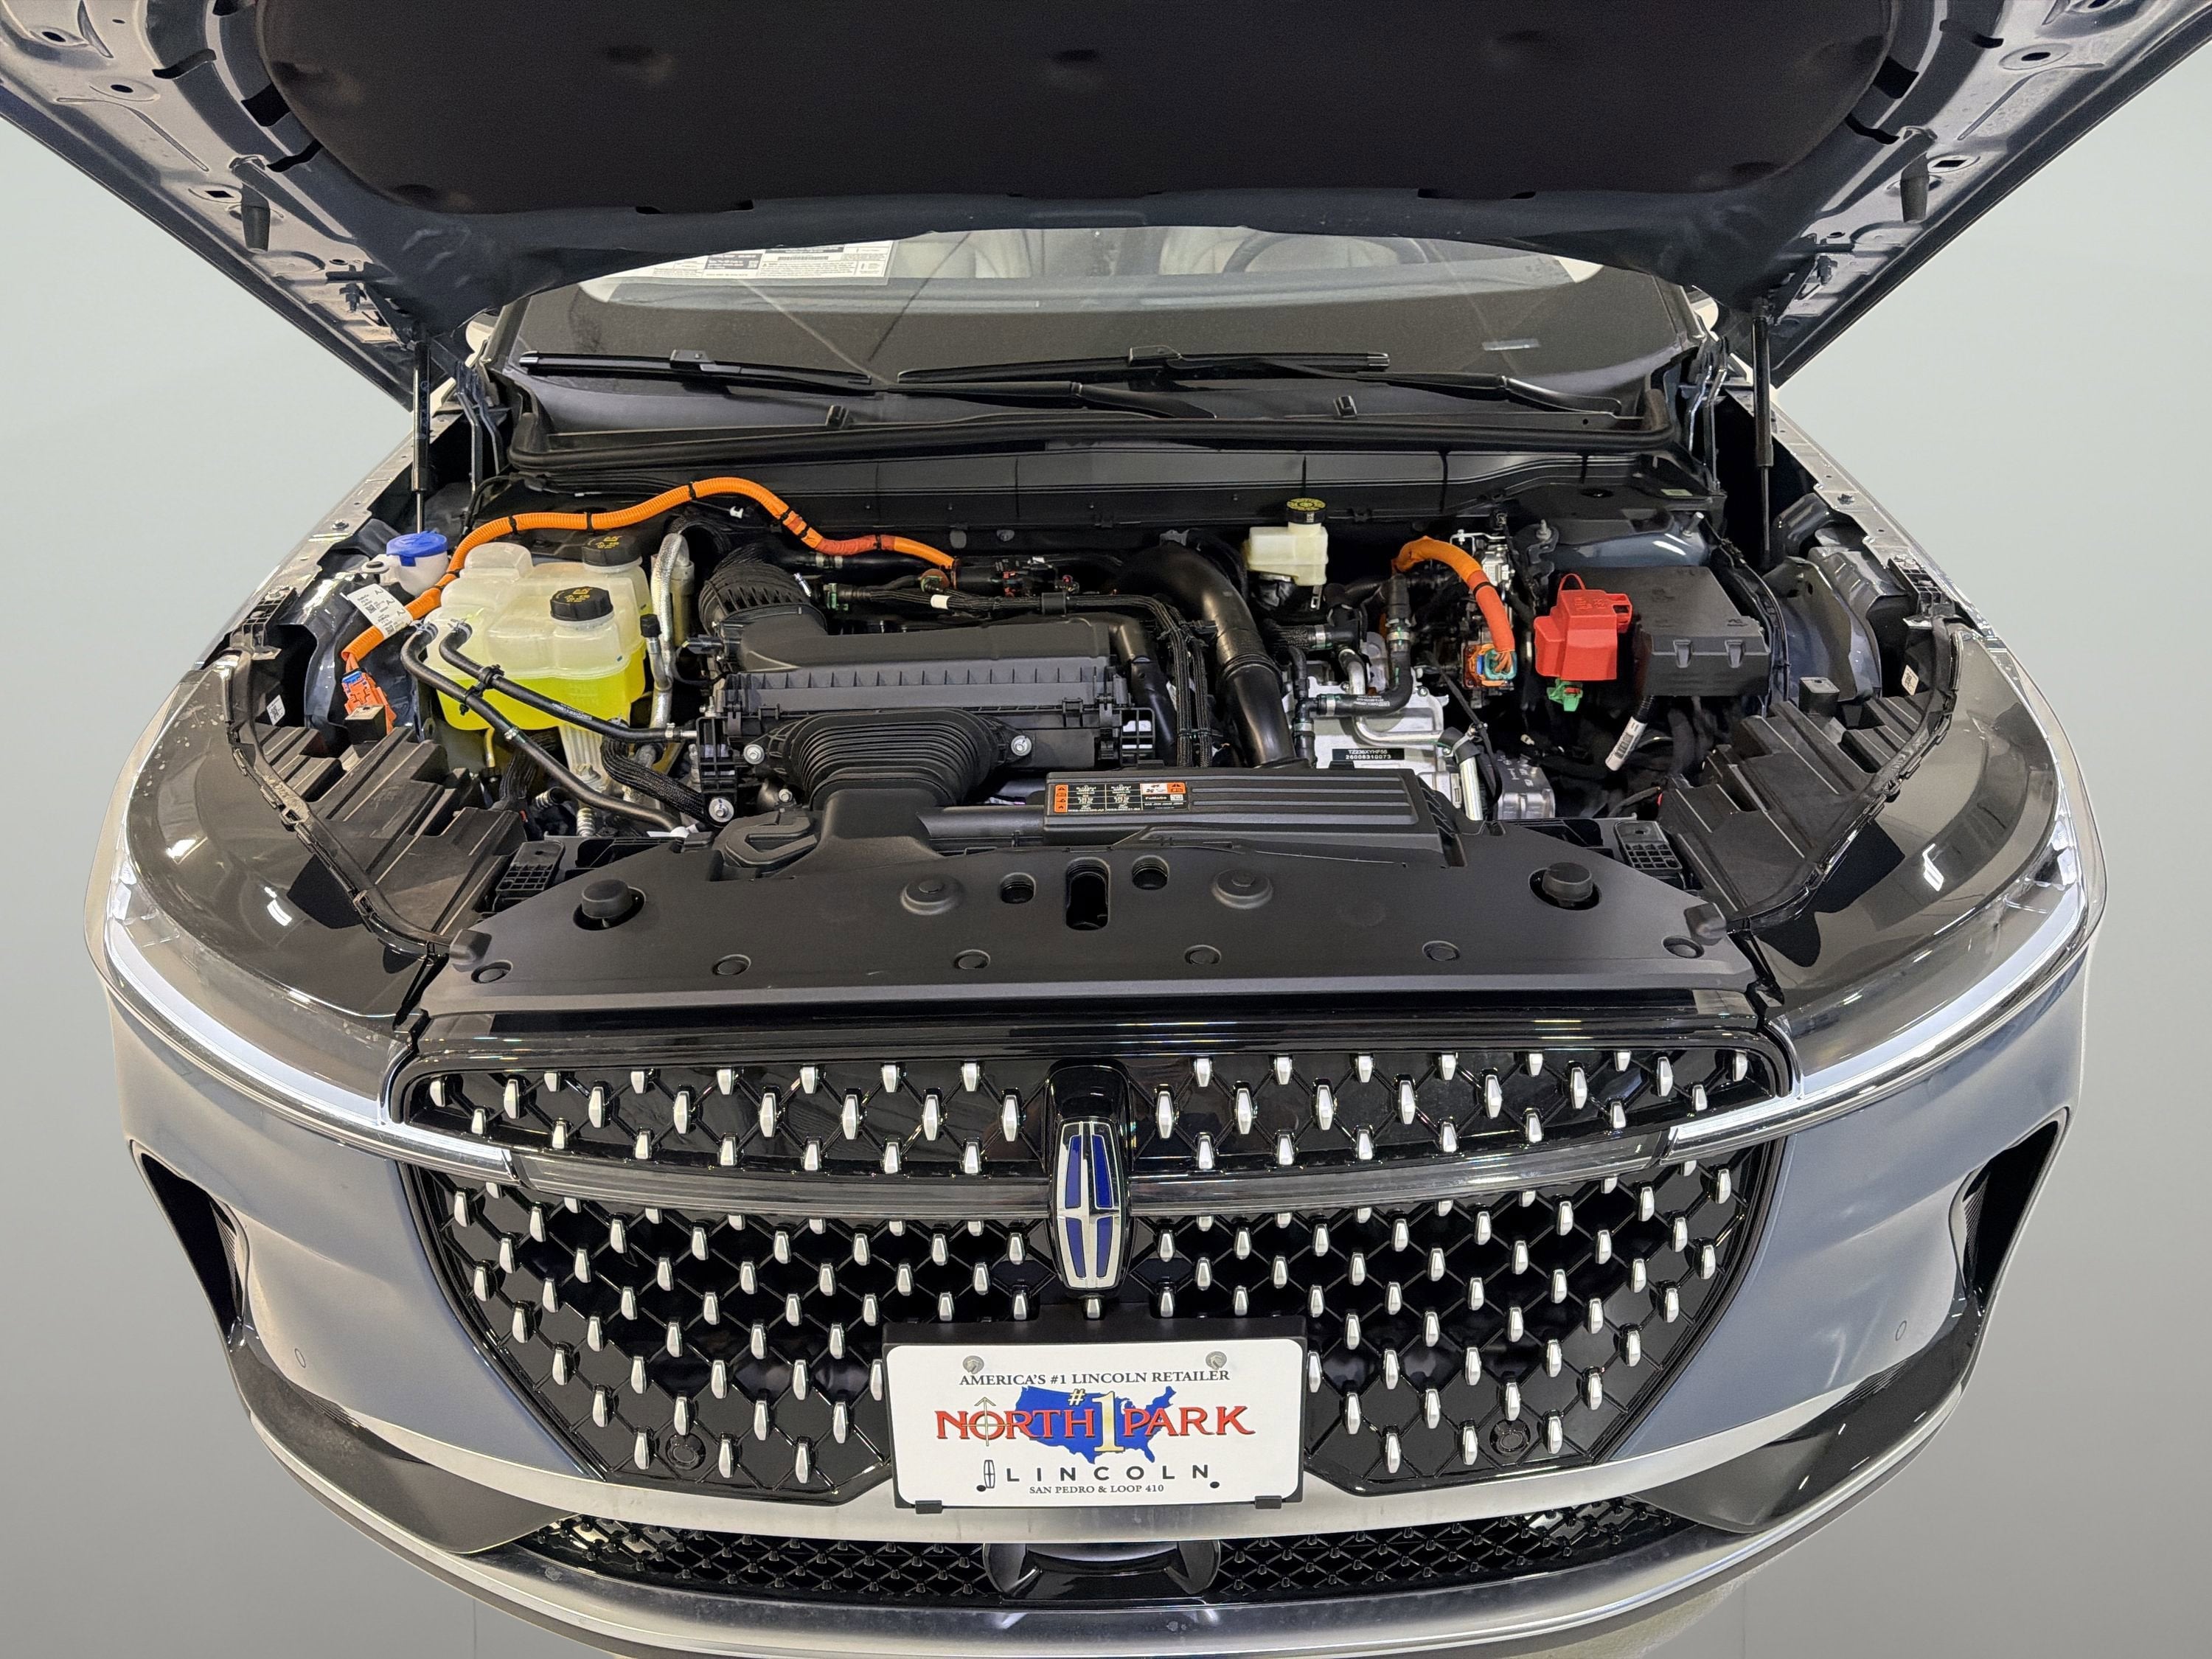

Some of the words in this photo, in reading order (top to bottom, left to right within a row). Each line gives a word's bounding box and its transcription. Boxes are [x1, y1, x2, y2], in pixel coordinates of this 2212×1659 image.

[959, 1374, 1046, 1385] AMERICA'S
[1050, 1374, 1066, 1385] #1
[1071, 1372, 1147, 1384] LINCOLN
[1152, 1370, 1231, 1382] RETAILER
[935, 1408, 1095, 1440] NORTH
[1123, 1405, 1256, 1437] PARK
[1006, 1464, 1208, 1482] LINCOLN
[1029, 1486, 1052, 1494] SAN
